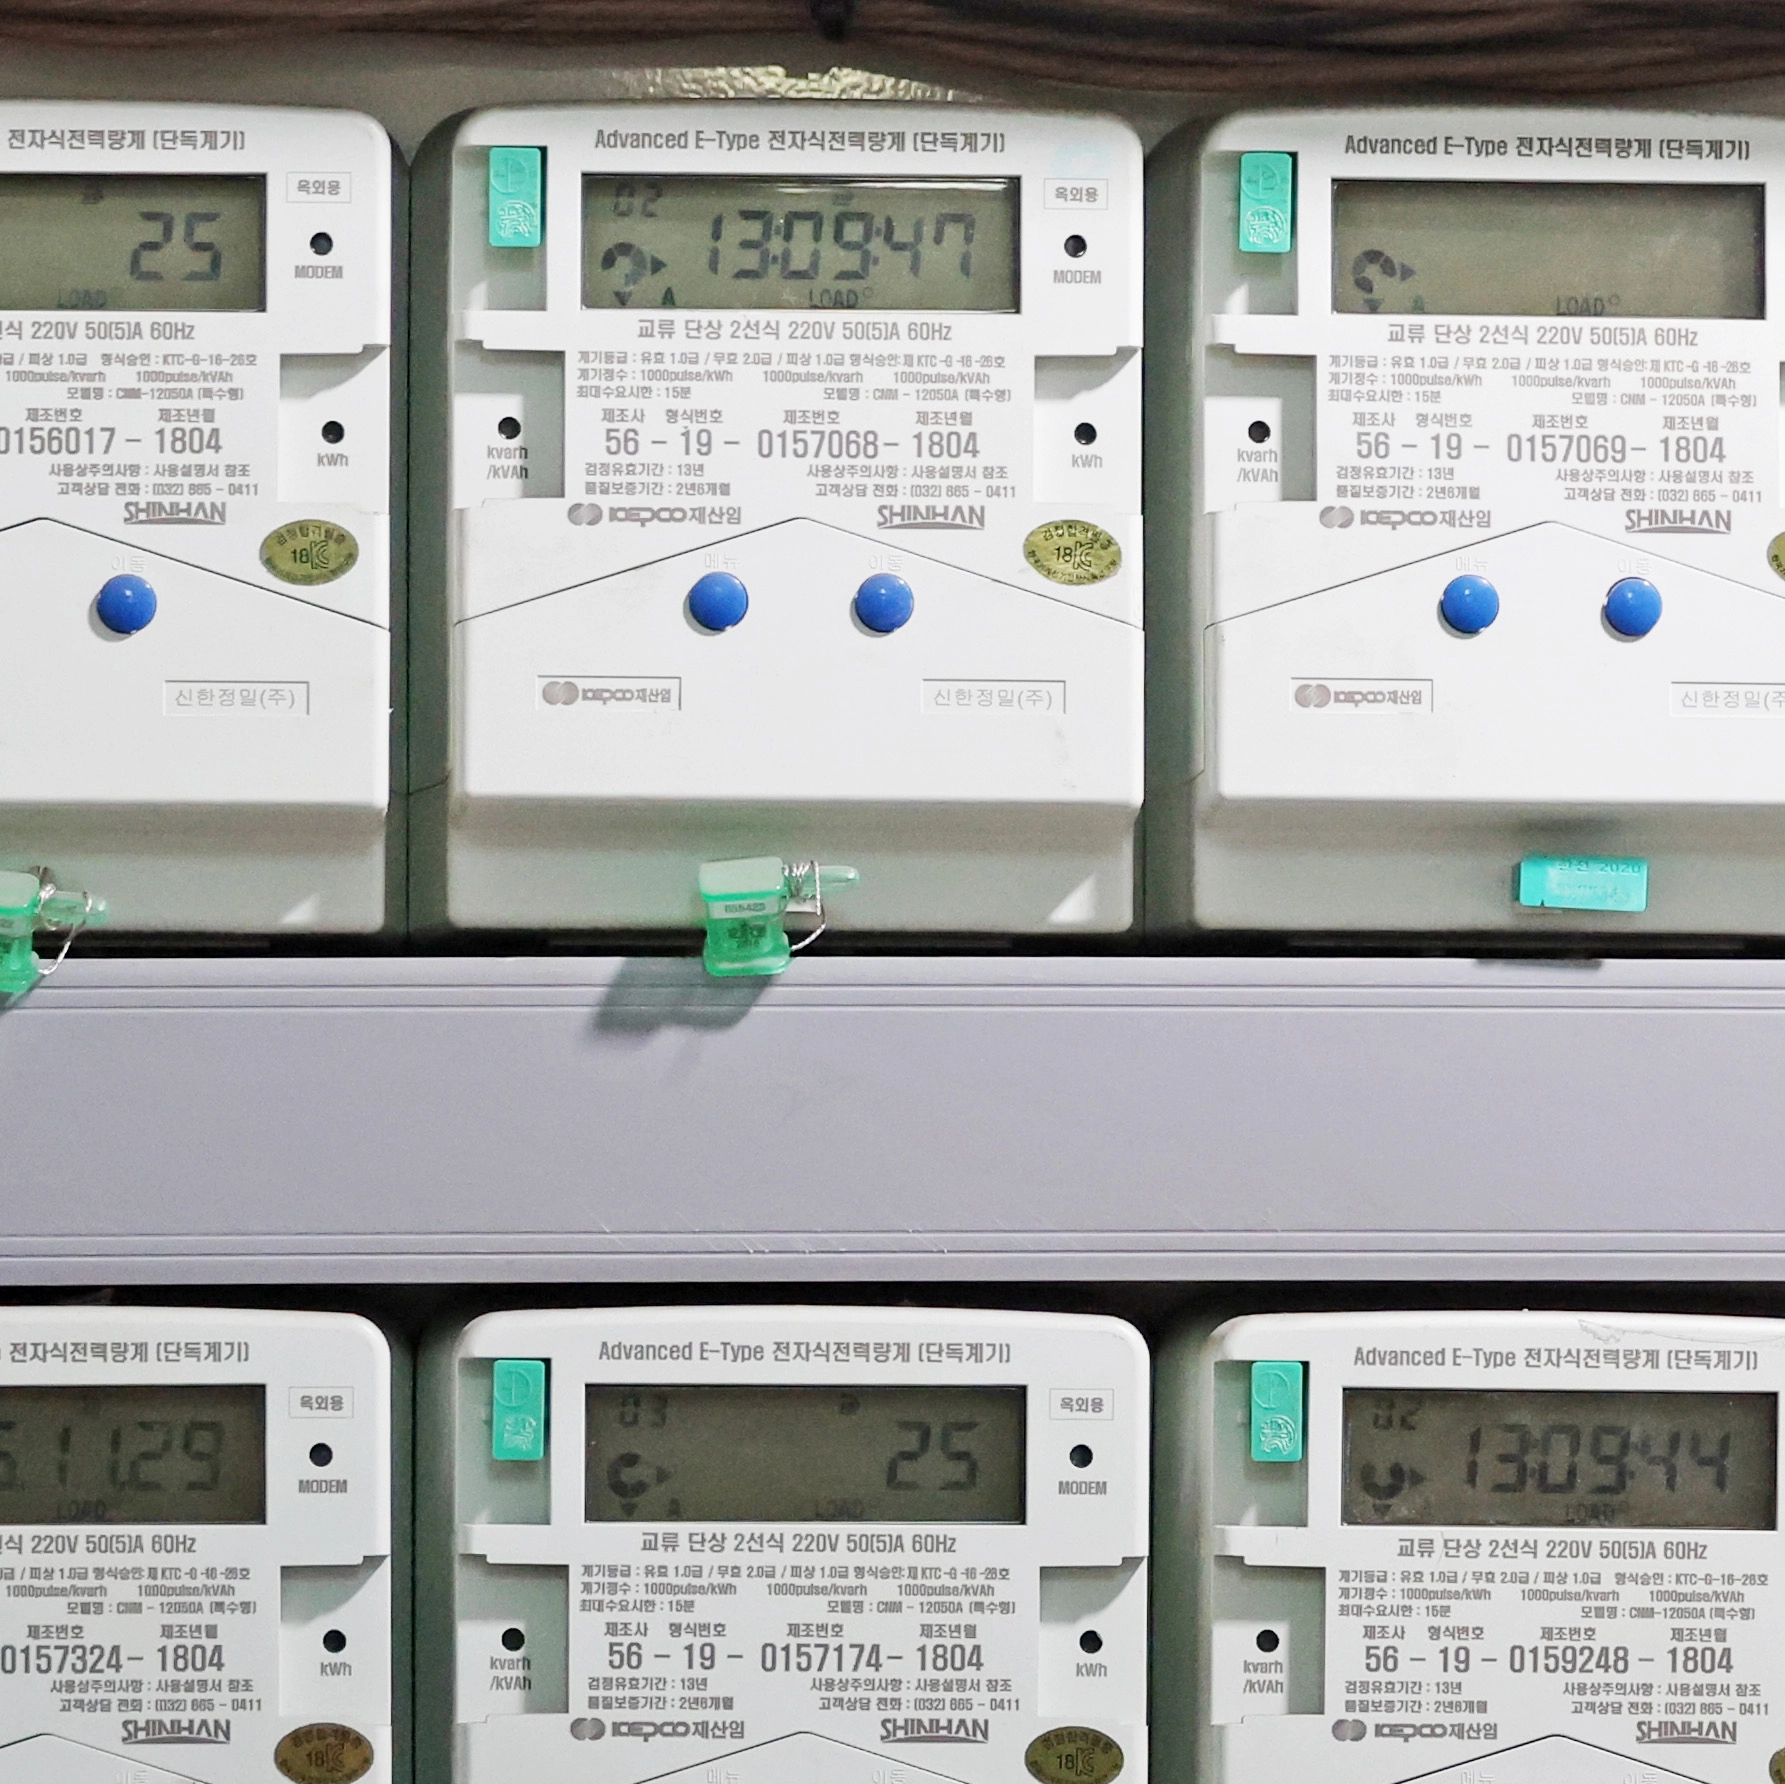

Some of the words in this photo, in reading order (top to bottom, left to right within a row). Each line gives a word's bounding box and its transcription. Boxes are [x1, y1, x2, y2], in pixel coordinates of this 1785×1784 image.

[595, 129, 688, 149] Advanced
[695, 130, 760, 151] E-Type
[1345, 135, 1437, 155] Advanced
[1444, 136, 1508, 157] E-Type
[129, 212, 221, 281] 25
[709, 210, 976, 280] 13:09:47
[1388, 324, 1425, 343] 교류
[1434, 324, 1472, 345] 단상
[1479, 325, 1528, 345] 2선식
[1537, 326, 1583, 345] 220V
[1654, 327, 1698, 346] 60Hz
[1391, 371, 1482, 386] 1000pulse/kWh
[1512, 373, 1611, 388] 1000pulse/kvarh
[1641, 375, 1735, 390] 1000pulse/kVAh
[1352, 412, 1395, 427] 제조사
[1416, 412, 1473, 428] 형식번호
[1532, 414, 1588, 429] 제조번호
[1662, 415, 1719, 431] 제조년월
[155, 427, 222, 454] 1804
[606, 428, 639, 455] 56
[681, 426, 712, 456] 19
[913, 431, 980, 458] 1804
[1357, 432, 1390, 459] 56
[1431, 433, 1462, 460] 19
[1660, 436, 1726, 463] 1804
[1237, 449, 1277, 463] kvarh
[1237, 467, 1278, 482] /kVAh
[1427, 466, 1455, 481] 13년
[1732, 489, 1762, 503] 0411
[1625, 509, 1731, 534] SHINHAN
[599, 1341, 692, 1360] Advanced
[700, 1342, 764, 1363] E-Type
[1354, 1347, 1445, 1366] Advanced
[1453, 1348, 1516, 1368] E-Type
[886, 1422, 980, 1491] 25
[1463, 1425, 1731, 1493] 13:09:44
[157, 1644, 225, 1672] 1804
[609, 1642, 642, 1670] 56
[684, 1643, 715, 1670] 19
[917, 1644, 984, 1671] 1804
[1510, 1645, 1629, 1674] 0159248
[1667, 1647, 1733, 1674] 1804
